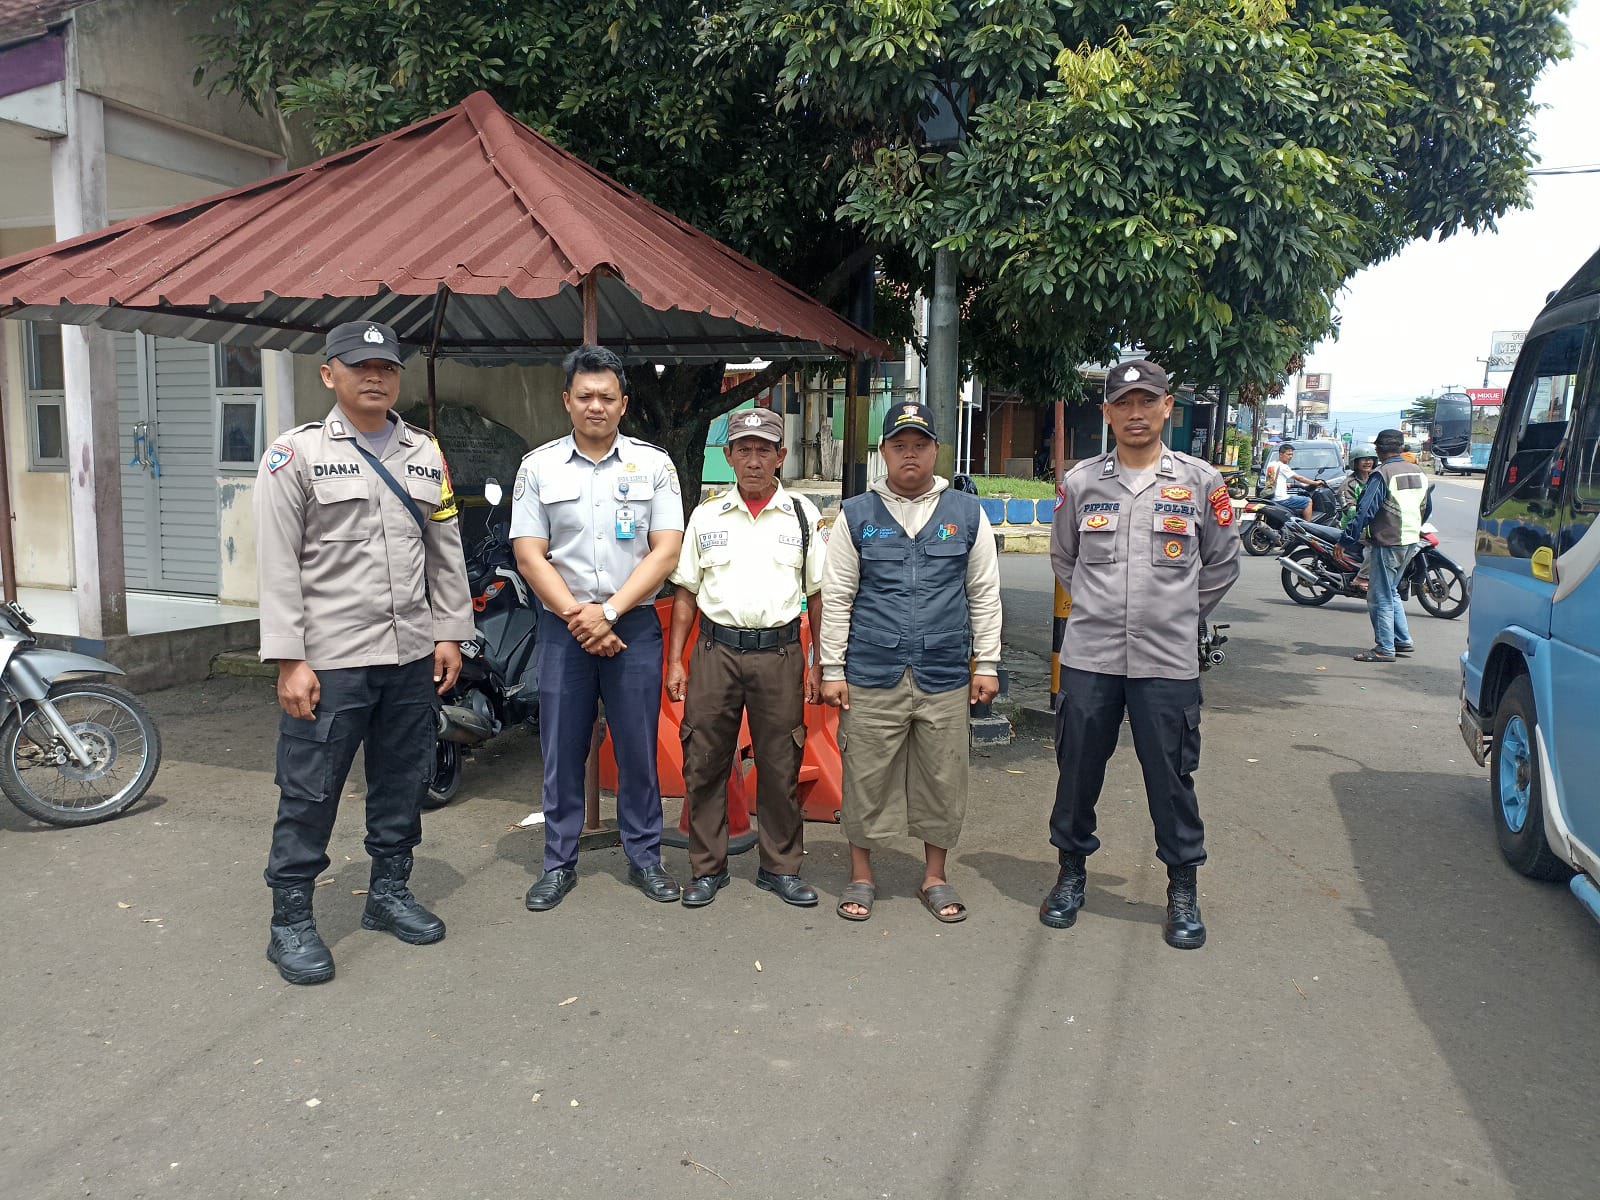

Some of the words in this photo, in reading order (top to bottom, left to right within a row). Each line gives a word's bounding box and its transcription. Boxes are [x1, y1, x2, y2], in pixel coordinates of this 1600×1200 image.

[314, 464, 360, 476] DIAN.H
[408, 464, 441, 480] POLRI
[1154, 503, 1196, 515] POLRI
